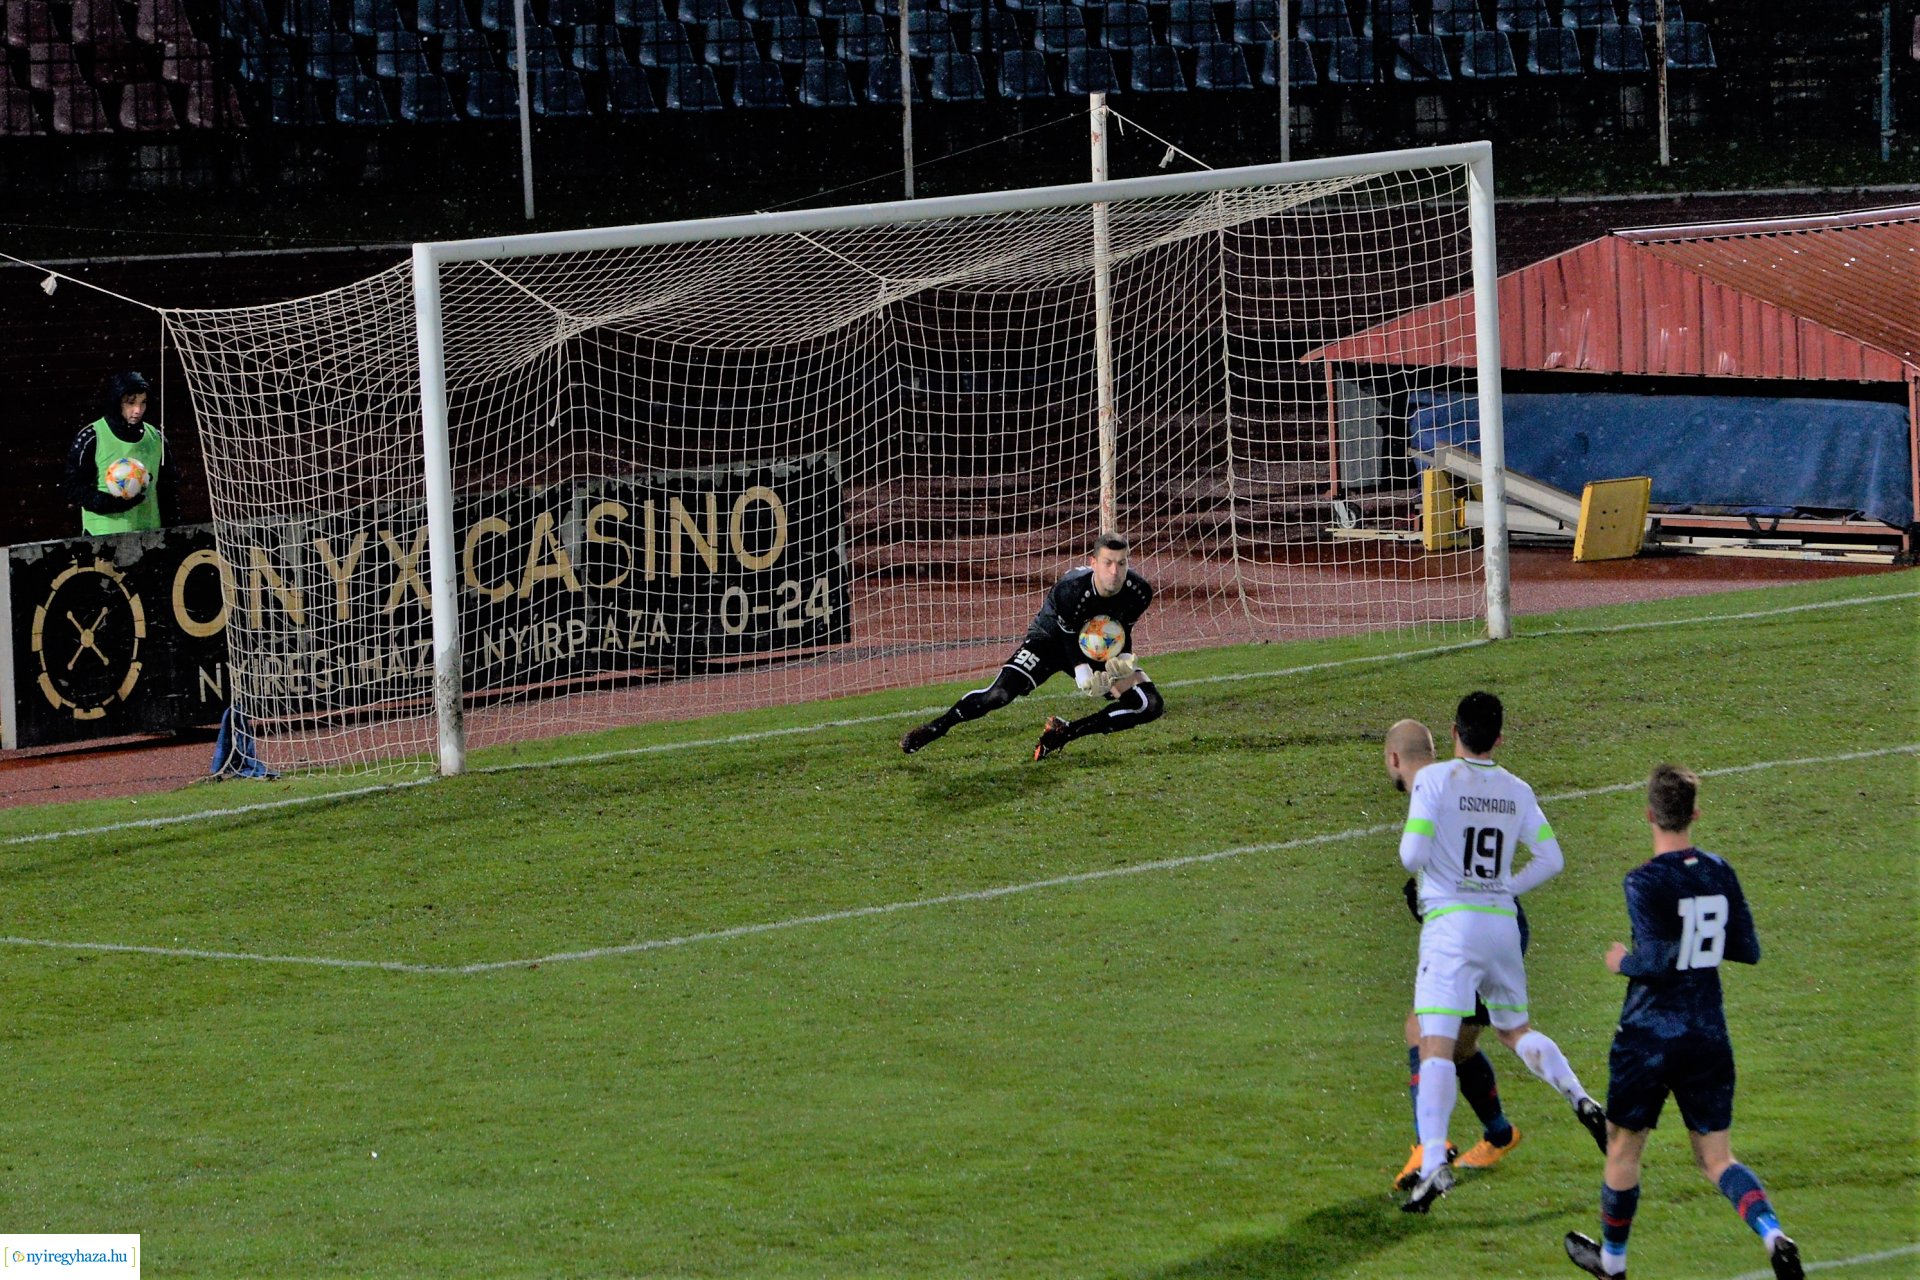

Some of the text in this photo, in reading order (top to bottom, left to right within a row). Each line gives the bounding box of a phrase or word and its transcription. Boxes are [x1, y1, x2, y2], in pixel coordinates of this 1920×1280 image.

[172, 485, 788, 638] ONYX CASINO
[720, 577, 834, 635] 0-24
[198, 634, 435, 703] NYÍREGYHÁZ
[1013, 648, 1041, 672] 95
[1459, 796, 1517, 815] CSIZMADIA
[1462, 826, 1504, 879] 19
[1676, 894, 1729, 971] 18
